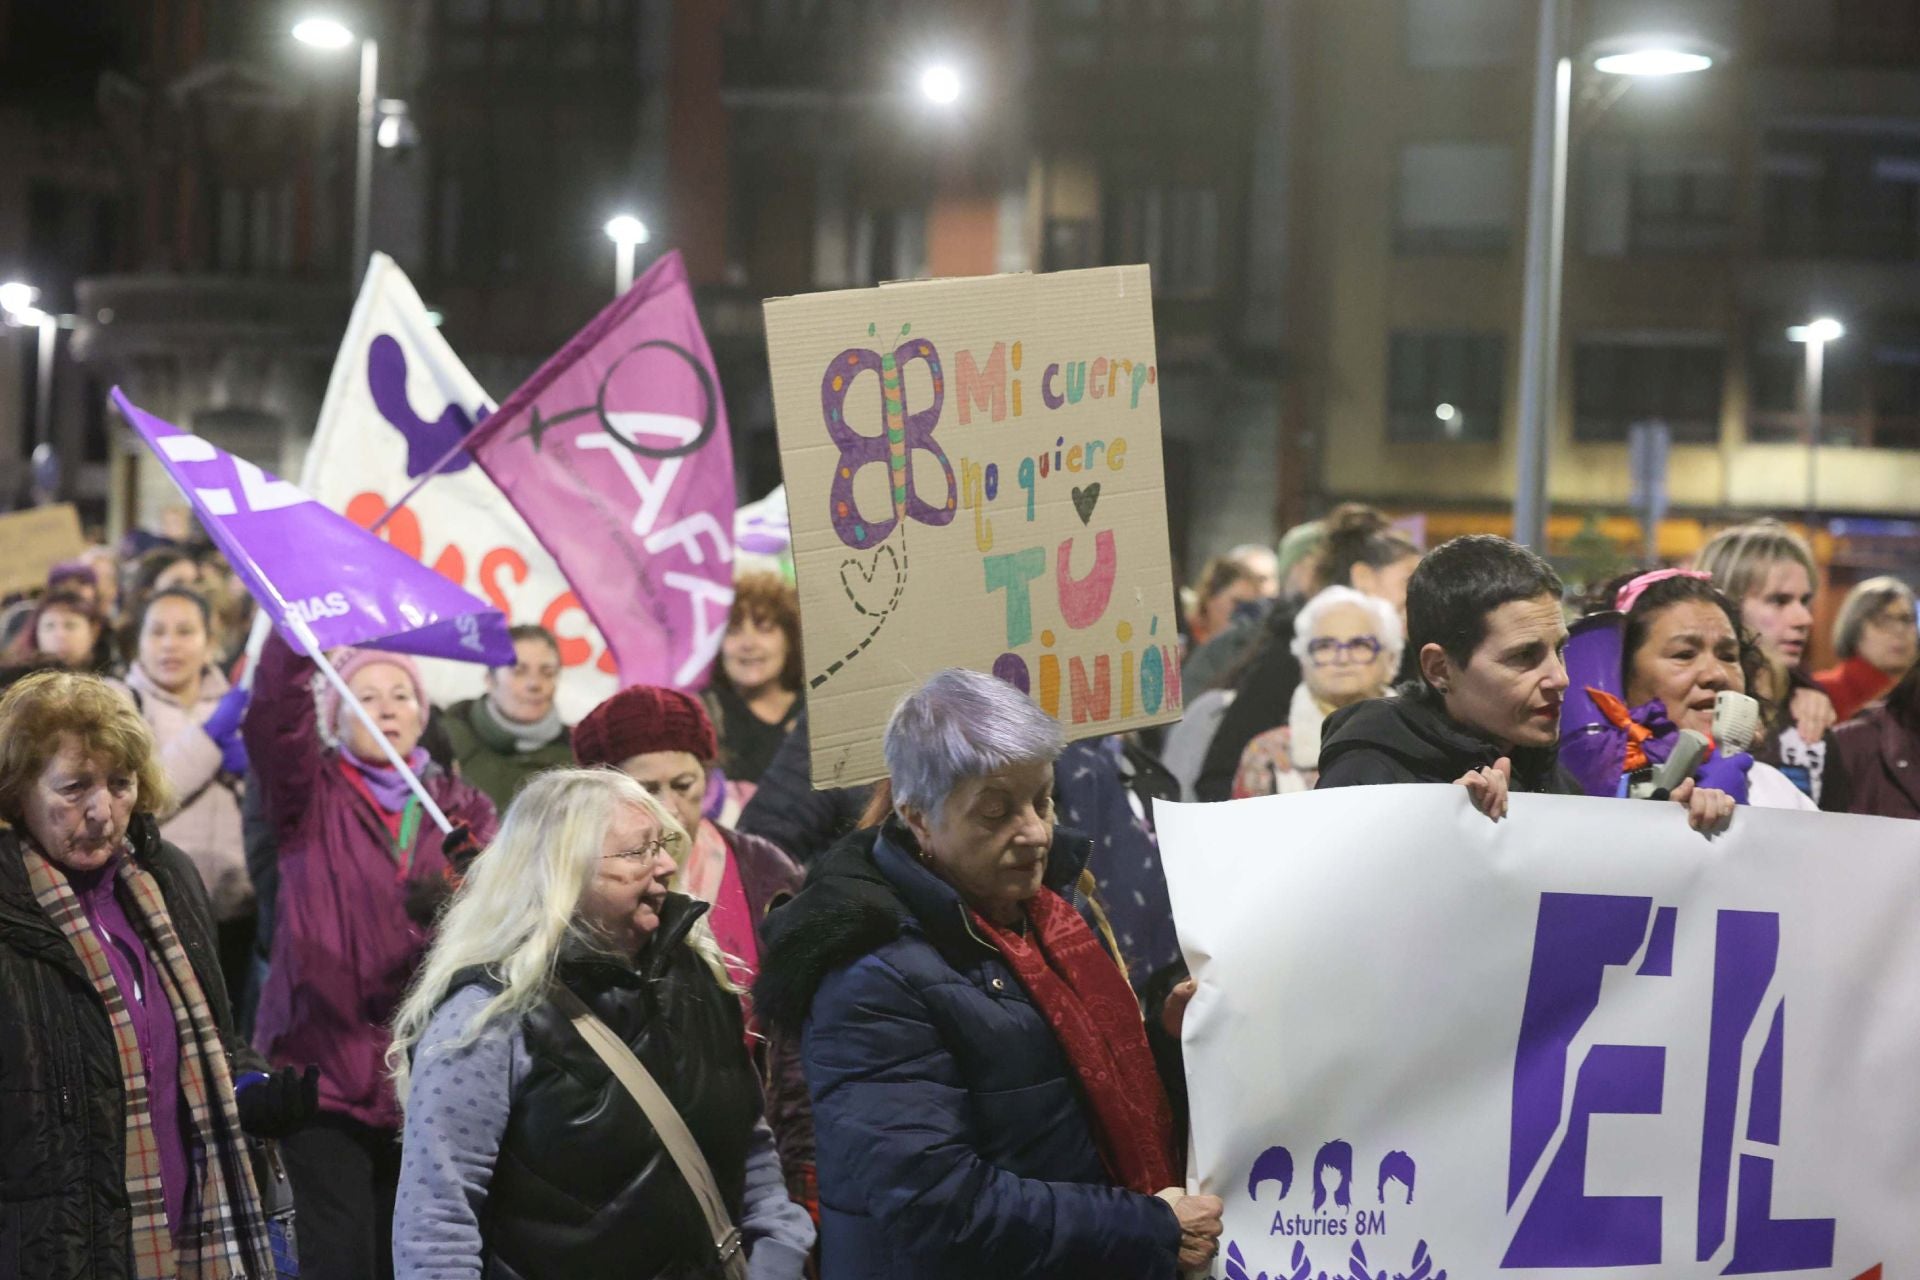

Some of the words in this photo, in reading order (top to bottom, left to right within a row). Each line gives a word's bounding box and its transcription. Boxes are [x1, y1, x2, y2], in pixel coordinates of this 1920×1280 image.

[955, 341, 1023, 425] Mi
[1041, 357, 1156, 410] cuerpo
[960, 456, 999, 552] no
[1018, 436, 1127, 522] quiere
[983, 528, 1117, 650] TU
[1500, 891, 1836, 1276] EL
[1269, 1209, 1348, 1236] Asturies
[1354, 1209, 1387, 1236] 8M
